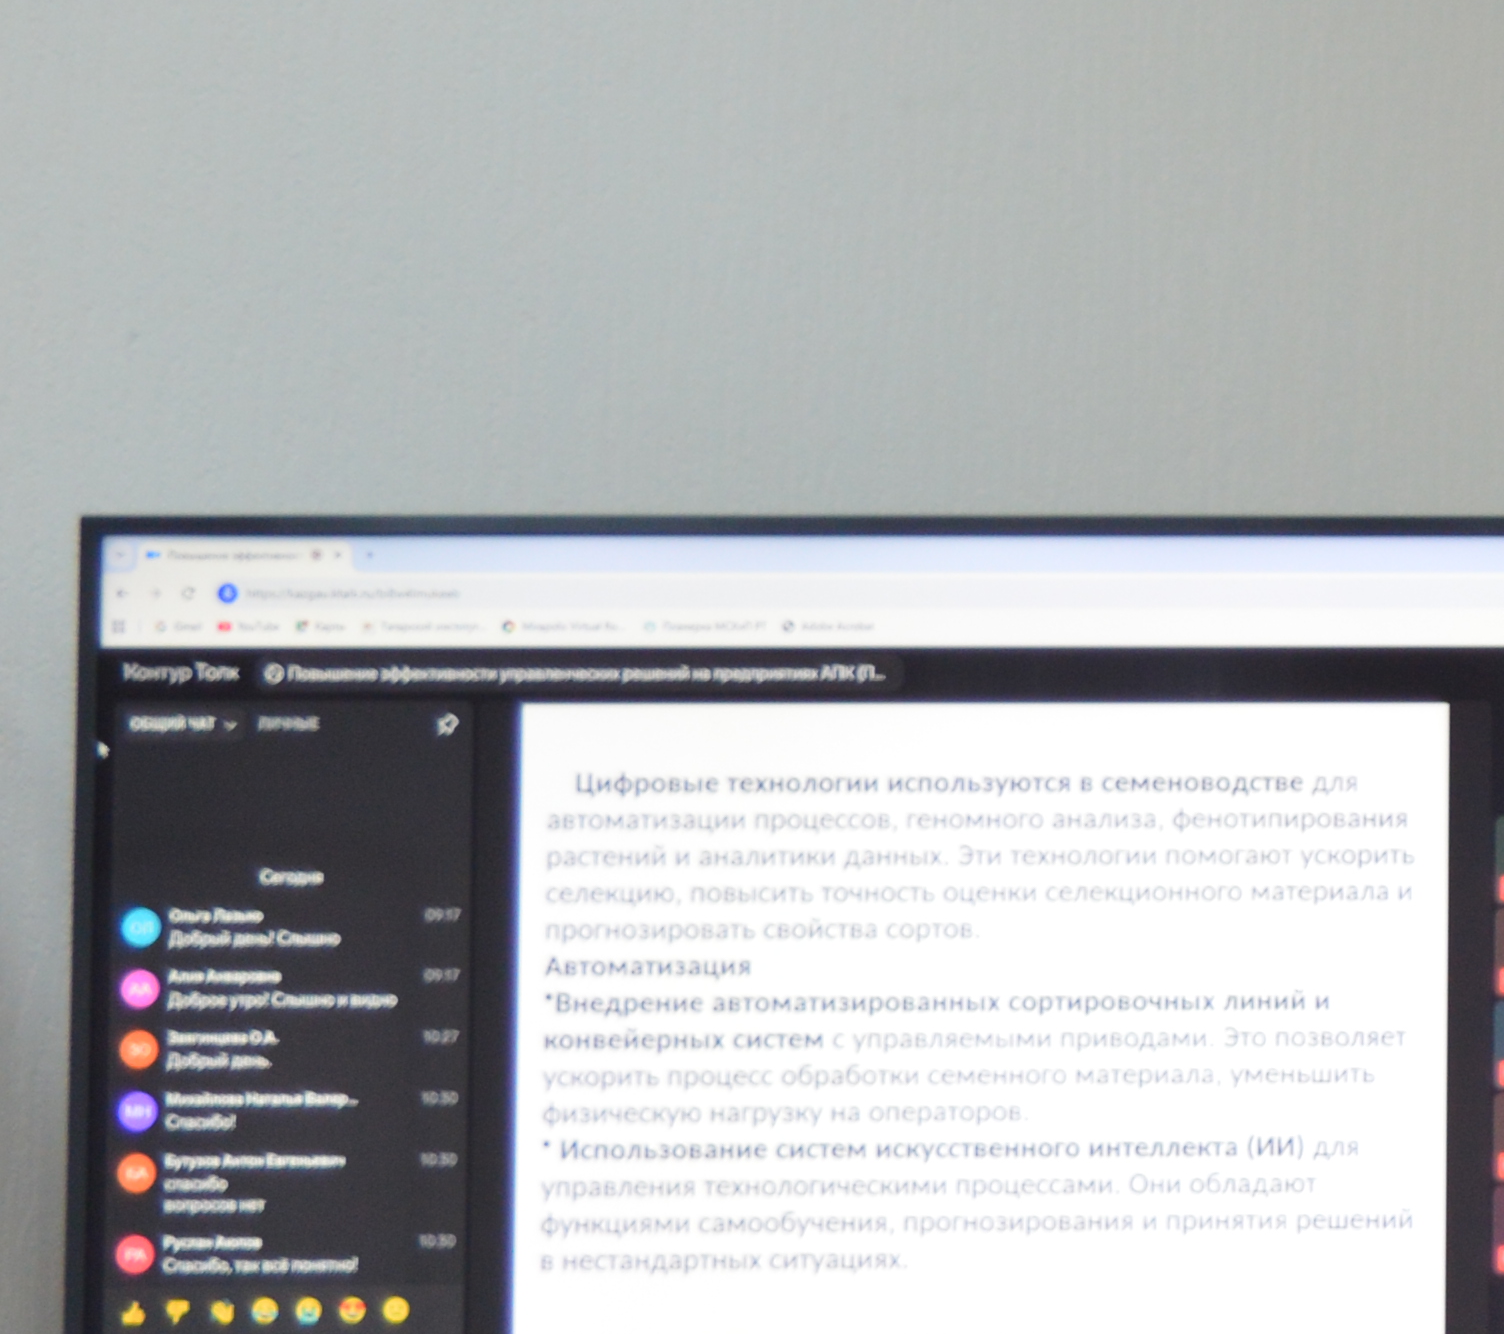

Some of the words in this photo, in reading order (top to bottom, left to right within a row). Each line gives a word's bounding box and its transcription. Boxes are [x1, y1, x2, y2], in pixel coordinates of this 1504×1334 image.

[123, 663, 193, 684] Контур
[195, 662, 239, 681] Толк
[287, 665, 379, 681] Повышение
[380, 666, 498, 683] эффективности
[498, 668, 620, 683] управленческих
[620, 665, 691, 683] решений
[691, 668, 712, 681] на
[712, 668, 818, 682] предприятиях
[818, 664, 856, 680] АПК
[573, 771, 720, 799] Цифровые
[726, 775, 880, 795] технологии
[886, 775, 1072, 798] используются
[1078, 775, 1094, 794] в
[1100, 775, 1305, 797] семеноводстве
[1310, 774, 1359, 797] для
[545, 812, 747, 835] автоматизации
[752, 811, 899, 835] процессов,
[905, 811, 1045, 831] геномного
[1050, 811, 1164, 832] анализа,
[1170, 807, 1409, 834] фенотипирования
[544, 843, 668, 873] растений
[673, 850, 691, 868] и
[697, 848, 837, 868] аналитики
[841, 848, 949, 871] данных.
[957, 843, 1003, 867] Эти
[1009, 848, 1158, 867] технологии
[1164, 848, 1293, 867] помогают
[1299, 847, 1416, 870] ускорить
[259, 868, 324, 886] Сегодня
[543, 885, 682, 908] селекцию,
[688, 885, 815, 905] повысить
[820, 885, 936, 904] точность
[941, 885, 1038, 907] оценки
[1044, 884, 1243, 906] селекционного
[1250, 884, 1390, 906] материала
[1396, 885, 1413, 902] и
[168, 930, 232, 948] Добрый
[232, 931, 276, 947] день!
[276, 930, 341, 946] Слышно
[543, 921, 757, 946] прогнозировать
[761, 917, 879, 941] свойства
[884, 921, 981, 944] сортов.
[543, 955, 753, 981] Автоматизация
[167, 991, 228, 1010] Доброе
[270, 991, 336, 1008] Слышно
[336, 995, 350, 1007] и
[350, 994, 398, 1009] видно
[711, 995, 1000, 1017] автоматизированных
[1007, 994, 1215, 1017] сортировочных
[1222, 988, 1306, 1012] линий
[1313, 994, 1331, 1011] и
[542, 1027, 725, 1055] конвейерных
[731, 1032, 825, 1051] систем
[831, 1032, 845, 1050] с
[851, 1031, 1052, 1054] управляемыми
[1059, 1031, 1214, 1053] приводами.
[1223, 1025, 1268, 1049] Это
[1274, 1029, 1407, 1048] позволяет
[166, 1052, 230, 1070] Добрый
[541, 1068, 661, 1093] ускорить
[666, 1068, 773, 1092] процесс
[779, 1062, 920, 1091] обработки
[926, 1067, 1068, 1086] семенного
[1074, 1067, 1222, 1090] материала,
[1229, 1066, 1376, 1089] уменьшить
[165, 1113, 236, 1130] Спасибо!
[540, 1102, 703, 1129] физическую
[708, 1105, 824, 1129] нагрузку
[829, 1105, 861, 1124] на
[867, 1104, 1029, 1127] операторов.
[558, 1138, 769, 1162] Использование
[774, 1142, 867, 1161] систем
[874, 1141, 1081, 1164] искусственного
[1087, 1140, 1239, 1158] интеллекта
[1246, 1134, 1305, 1161] (ИИ)
[1312, 1139, 1360, 1161] для
[164, 1175, 228, 1192] спасибо
[539, 1179, 697, 1203] управления
[702, 1178, 948, 1198] технологическими
[955, 1177, 1120, 1200] процессами.
[1127, 1172, 1182, 1196] Они
[1188, 1171, 1318, 1198] обладают
[163, 1199, 238, 1214] вопросов
[238, 1199, 265, 1212] нет
[539, 1212, 691, 1240] функциями
[696, 1209, 895, 1238] самообучения,
[902, 1214, 1134, 1238] прогнозирования
[1141, 1215, 1158, 1232] и
[1165, 1213, 1288, 1236] принятия
[1295, 1207, 1414, 1235] решений
[234, 1260, 261, 1273] так
[538, 1253, 555, 1273] в
[560, 1252, 762, 1276] нестандартных
[767, 1251, 909, 1275] ситуациях.
